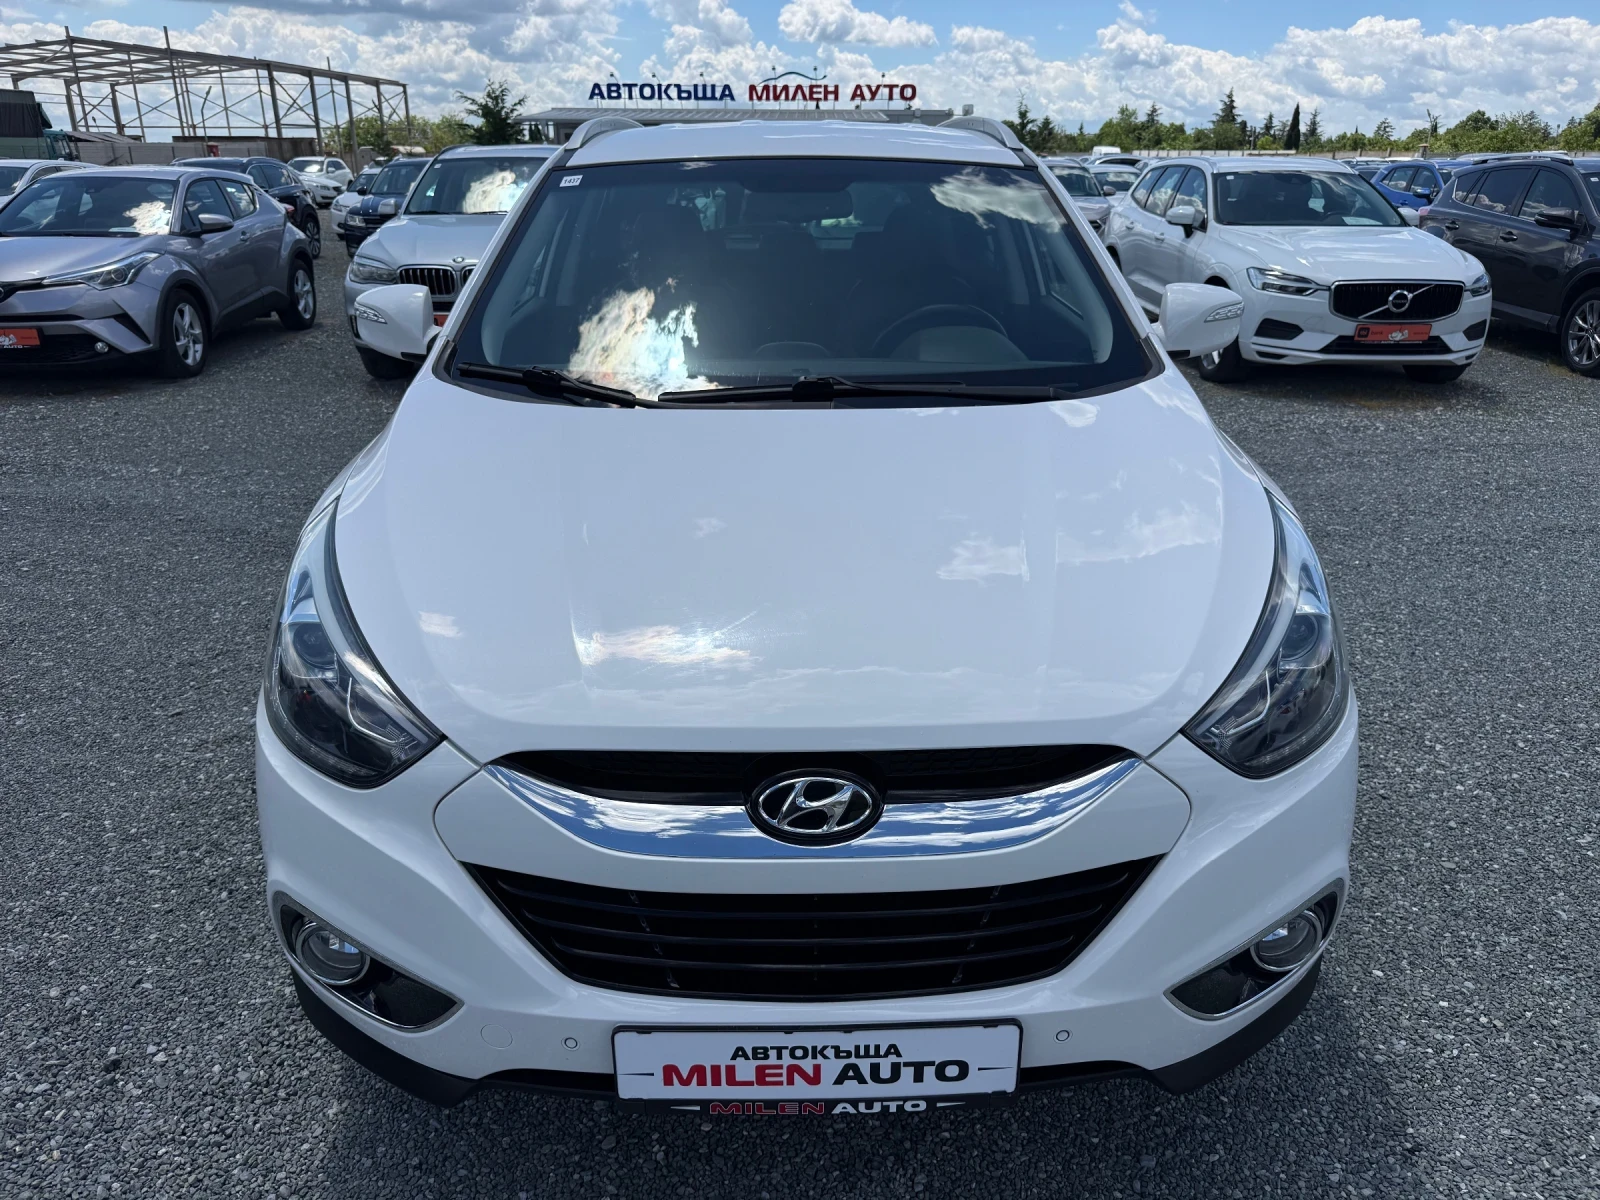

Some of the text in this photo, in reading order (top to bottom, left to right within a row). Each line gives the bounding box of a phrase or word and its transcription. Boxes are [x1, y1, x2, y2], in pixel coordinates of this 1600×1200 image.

[588, 82, 917, 102] АВТОКЪЩА МИЛЕН АУТО
[730, 1043, 903, 1061] АВТОКЪЩА
[662, 1059, 970, 1087] MILEN AUTO
[709, 1100, 927, 1115] MILEN AUTO
